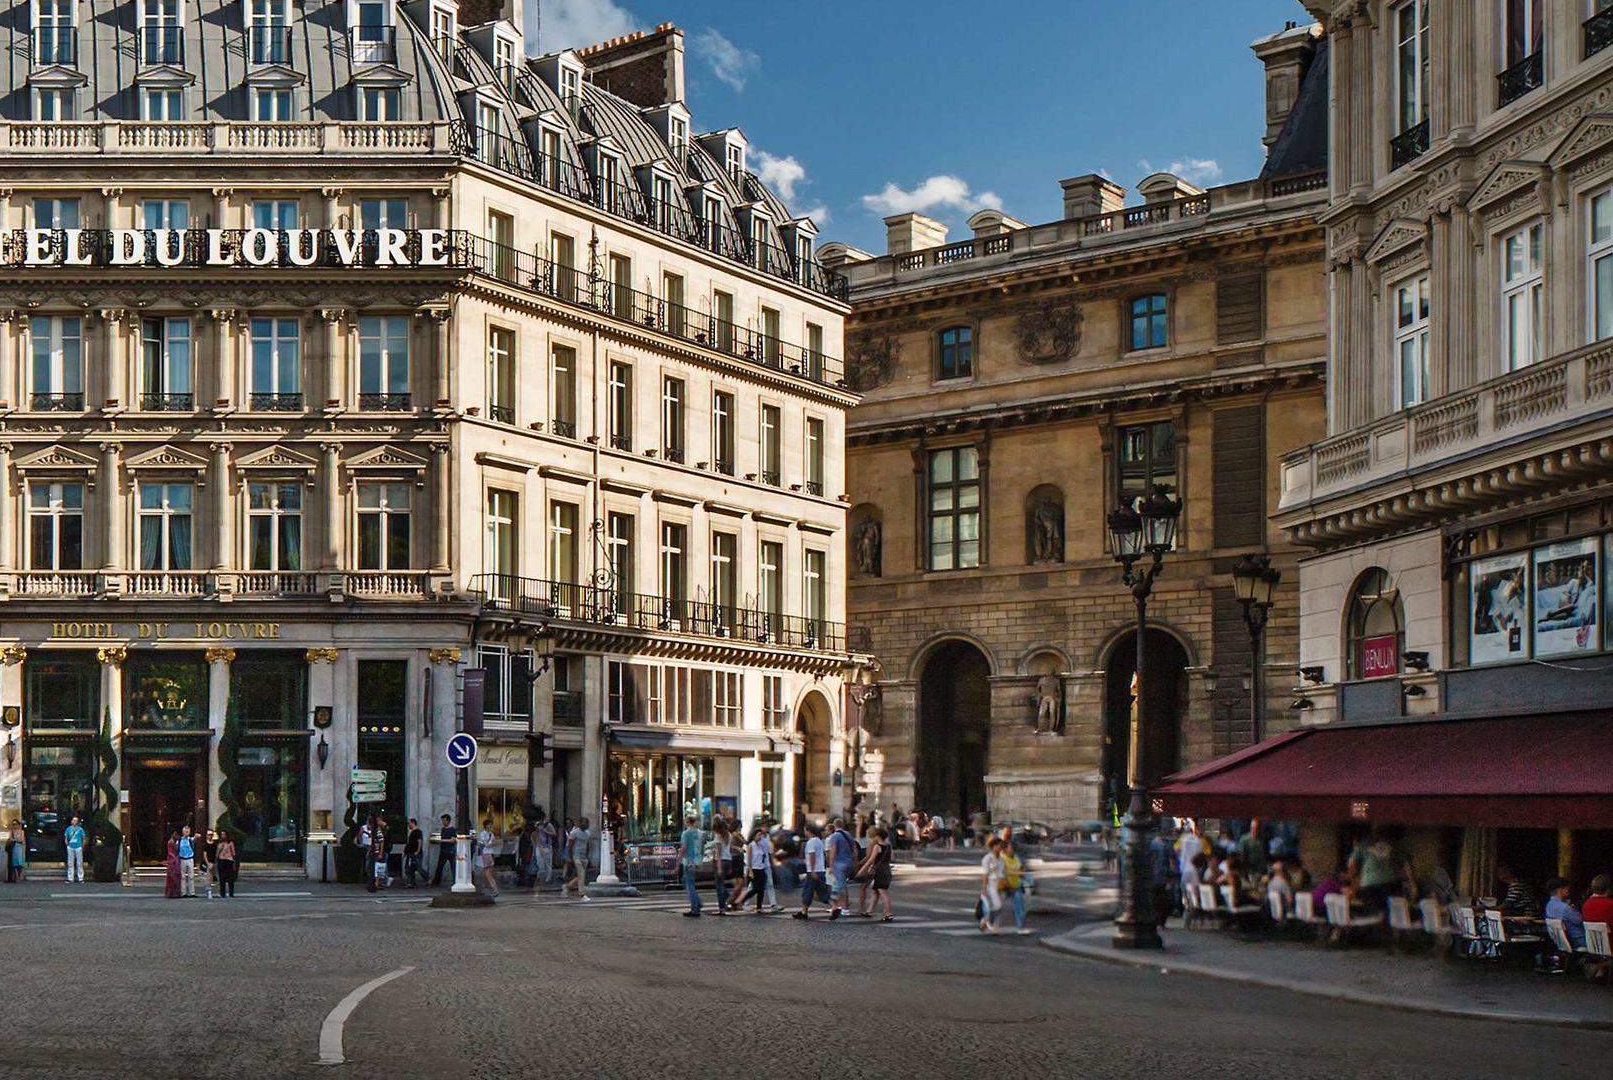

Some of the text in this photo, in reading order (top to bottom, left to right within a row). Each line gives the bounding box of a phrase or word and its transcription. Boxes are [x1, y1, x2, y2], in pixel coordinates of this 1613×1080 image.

[109, 228, 188, 266] DU
[206, 228, 449, 266] LOUVRE
[51, 622, 281, 638] HOTEL DU LOUVRE
[1365, 647, 1395, 670] BENLUX
